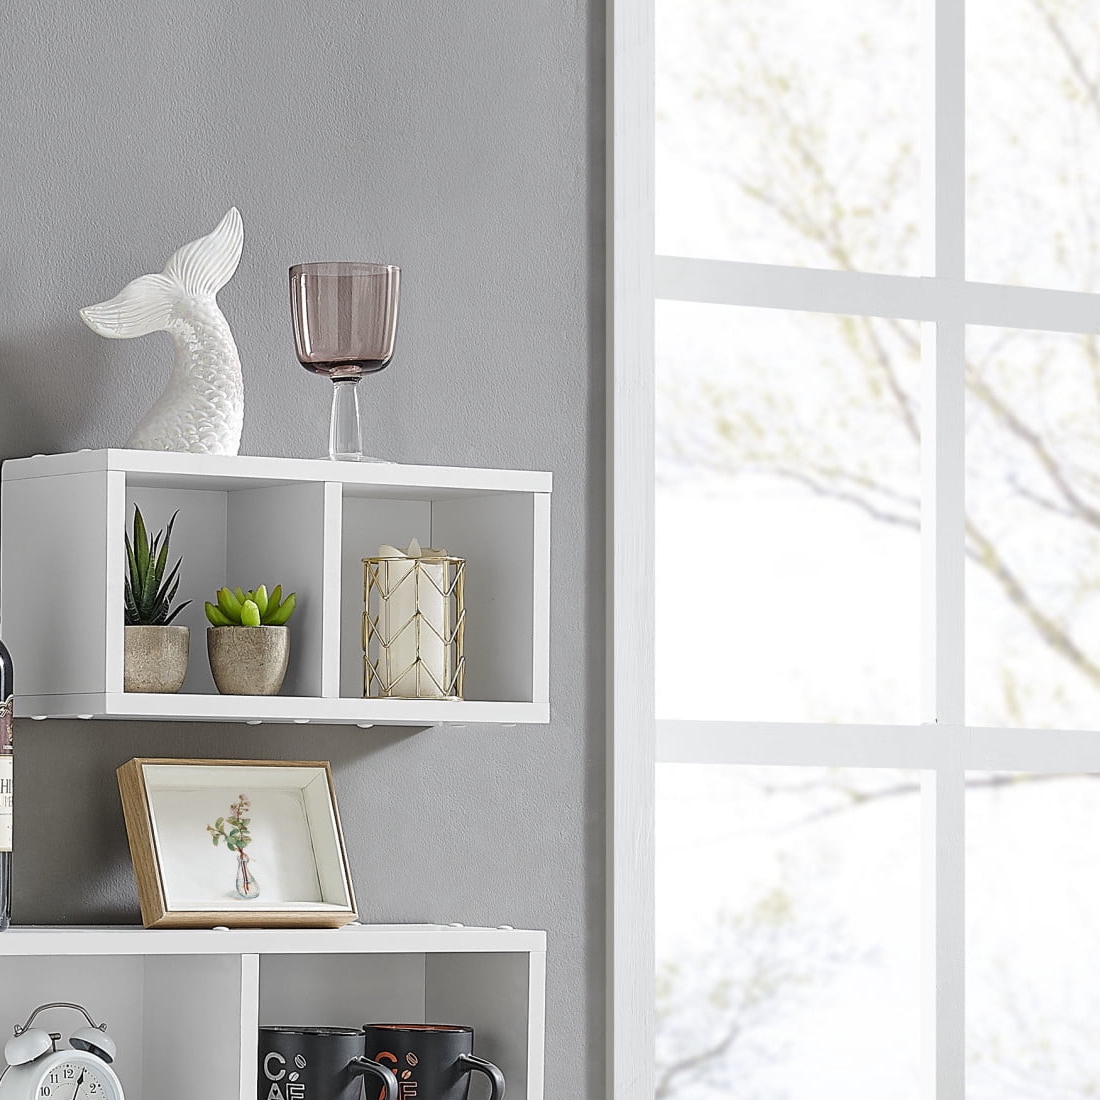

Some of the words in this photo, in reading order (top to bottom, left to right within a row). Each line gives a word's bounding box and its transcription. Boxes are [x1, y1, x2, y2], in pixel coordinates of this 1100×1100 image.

[50, 1074, 59, 1083] 11
[63, 1069, 74, 1079] 12
[40, 1086, 51, 1096] 10
[89, 1083, 97, 1093] 2
